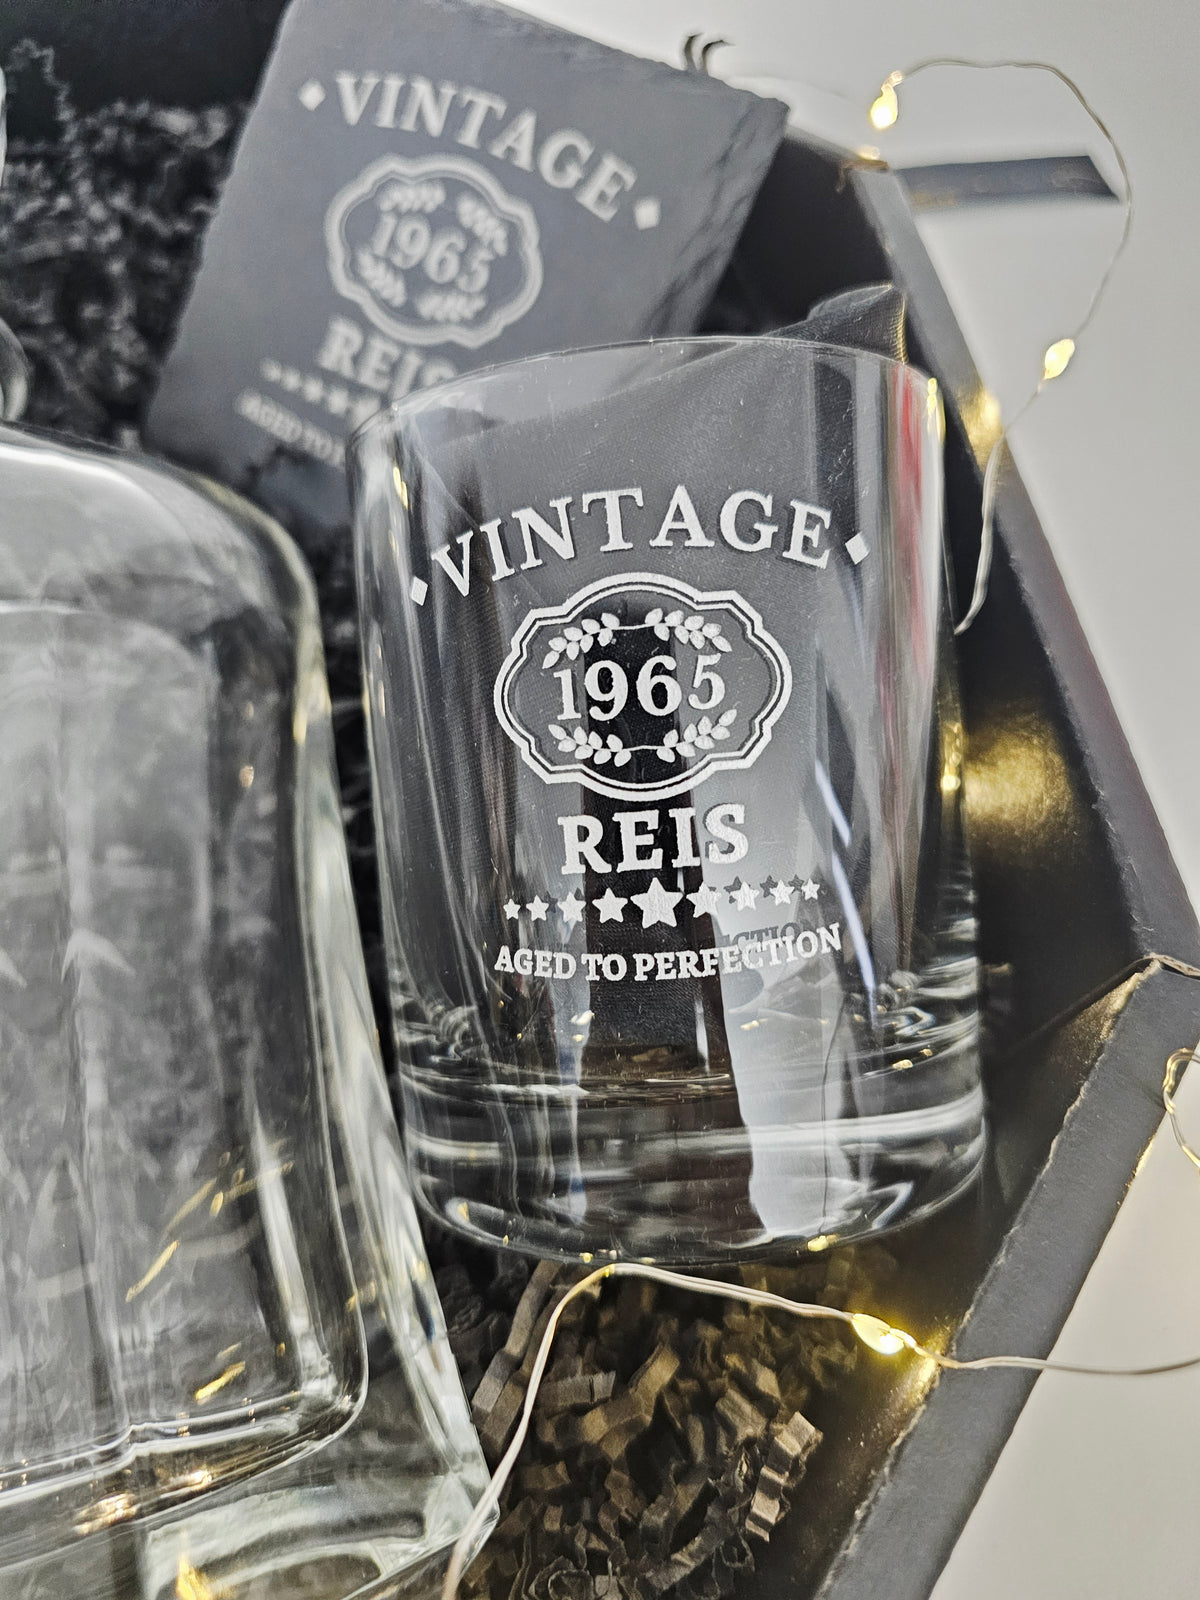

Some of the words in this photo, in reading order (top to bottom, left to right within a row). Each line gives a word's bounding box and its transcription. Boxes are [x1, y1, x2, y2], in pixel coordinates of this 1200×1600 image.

[335, 71, 636, 222] VINTAGE
[371, 214, 493, 293] 1965
[431, 485, 831, 597] VINTAGE
[553, 654, 726, 721] 1965
[557, 803, 749, 875] REIS
[494, 945, 576, 979] AGED
[581, 953, 627, 981] TO
[633, 922, 843, 981] PERFECTION
